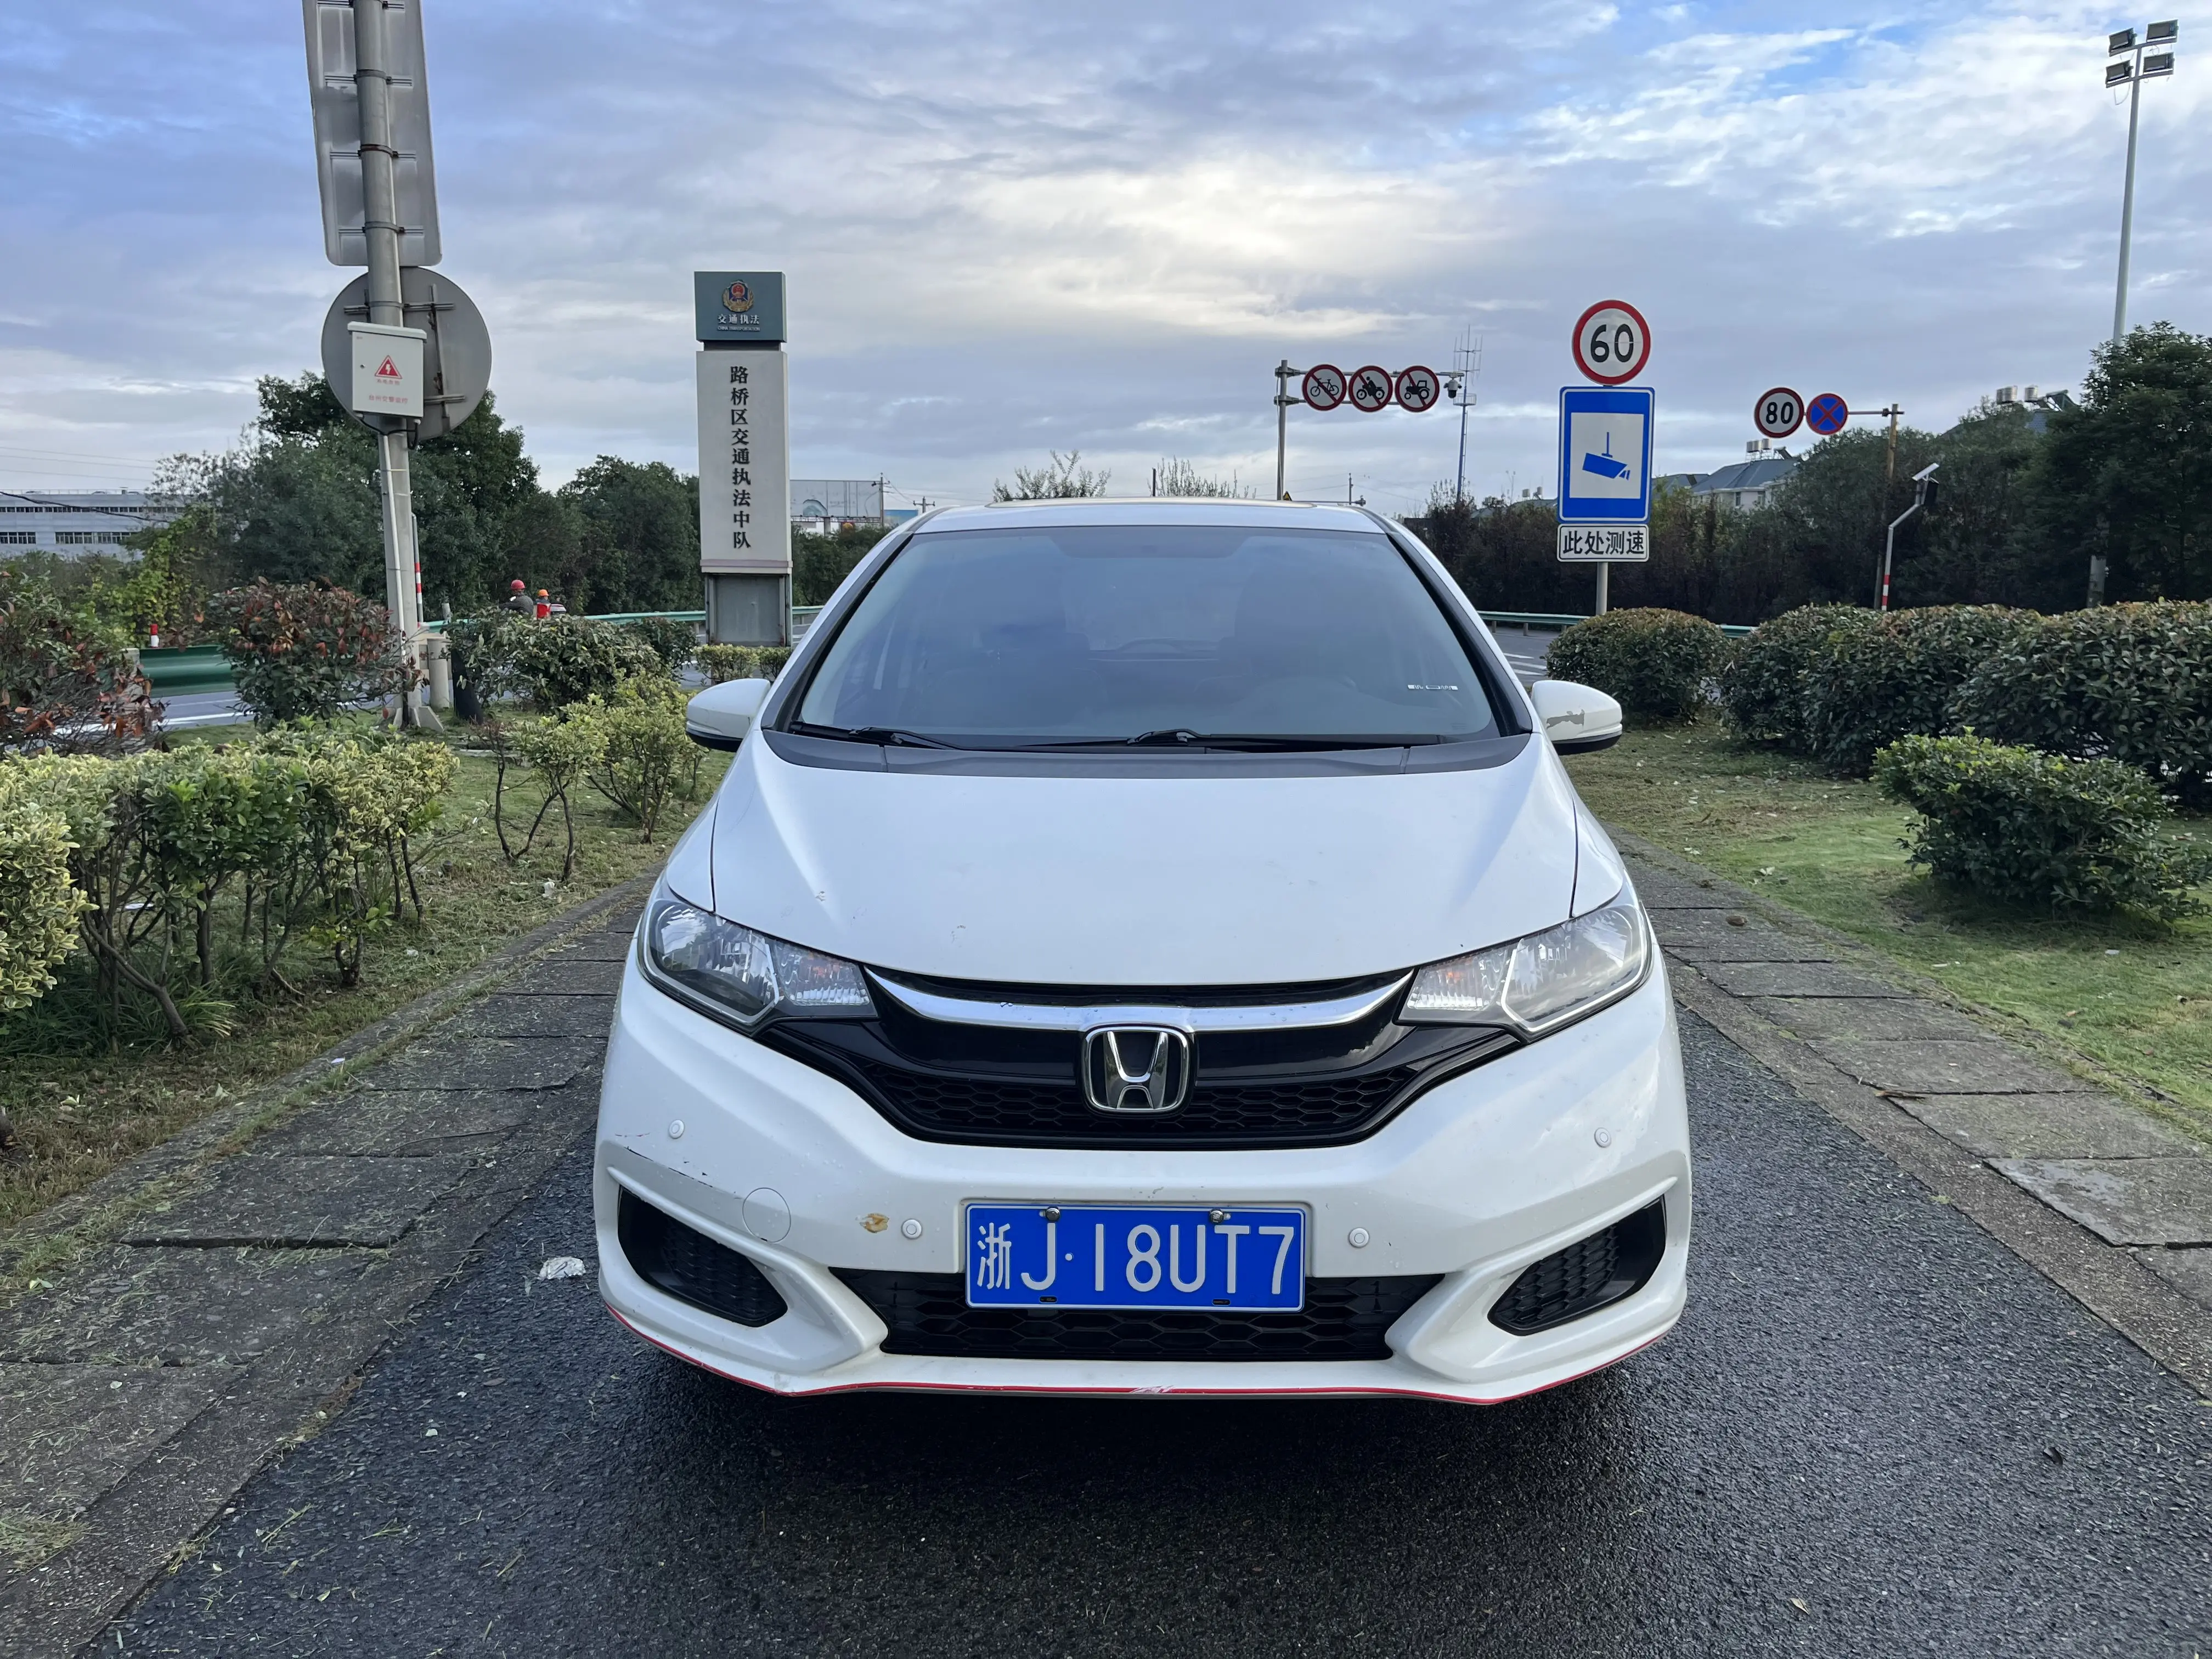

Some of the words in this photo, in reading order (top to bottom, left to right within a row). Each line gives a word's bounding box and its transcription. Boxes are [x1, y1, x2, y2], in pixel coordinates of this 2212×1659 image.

[718, 313, 760, 324] 交通执法
[1590, 324, 1634, 363] 60
[1765, 402, 1793, 424] 80
[730, 366, 751, 549] 路桥区交通执法中队
[1562, 530, 1645, 555] 此处测速
